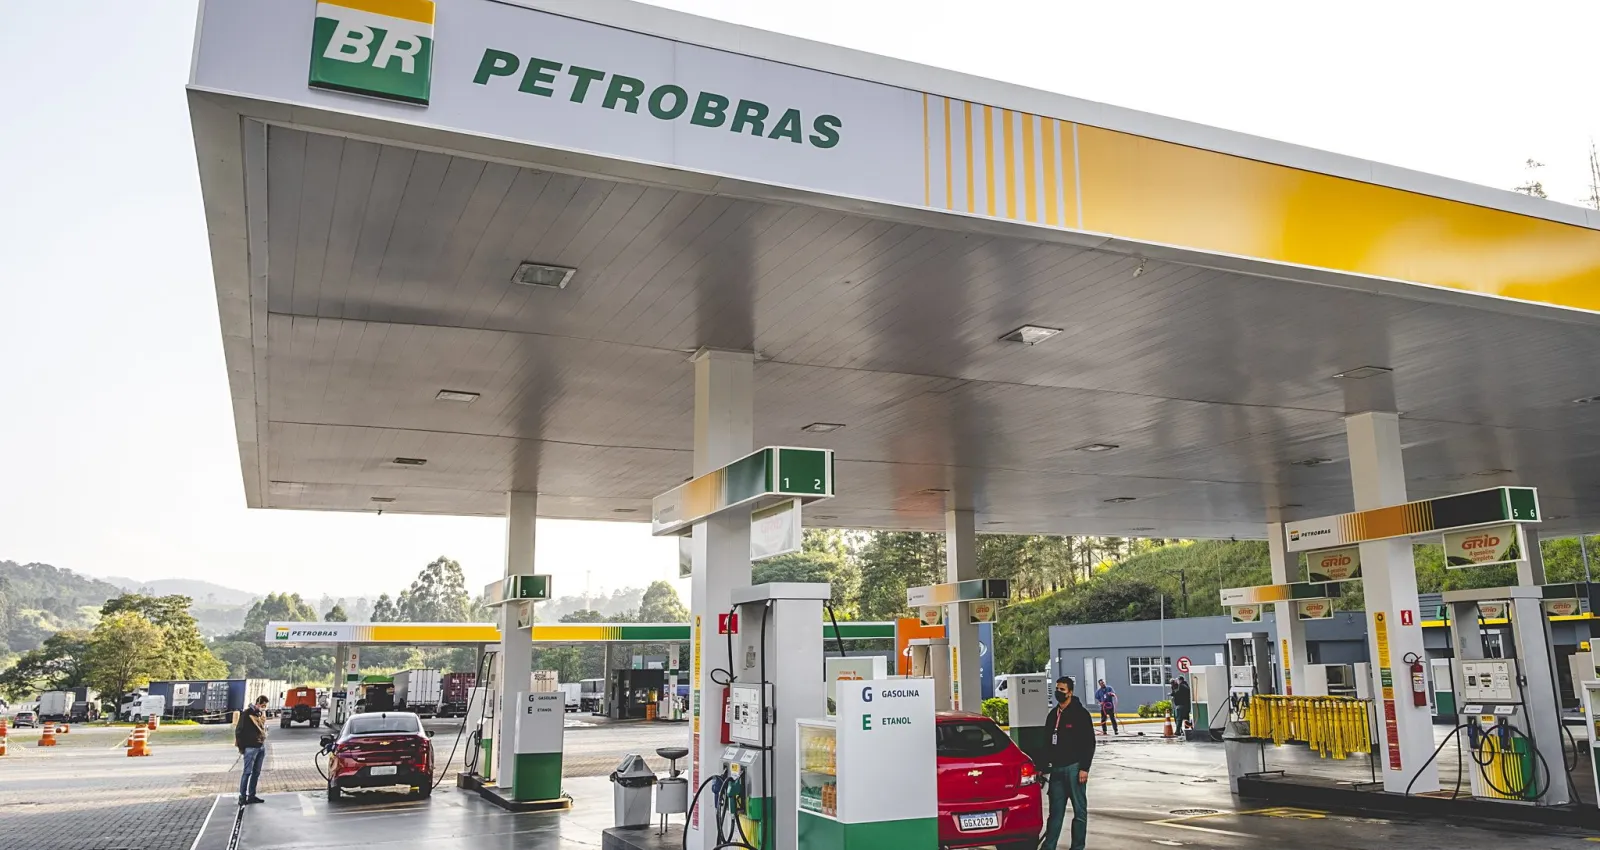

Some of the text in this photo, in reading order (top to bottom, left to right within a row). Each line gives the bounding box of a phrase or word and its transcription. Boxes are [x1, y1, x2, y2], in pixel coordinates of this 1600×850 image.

[323, 19, 422, 74] BR
[473, 48, 842, 149] PETROBRAS
[784, 477, 821, 490] 1 2
[1513, 508, 1535, 518] 5 6
[1301, 529, 1331, 538] PETROBRAS
[1461, 535, 1500, 550] GRID
[1321, 554, 1352, 568] GRID
[1305, 604, 1323, 612] GRID
[528, 694, 535, 702] G
[862, 686, 920, 702] G GASOLINA
[527, 706, 533, 714] E
[862, 714, 912, 730] E ETANOL
